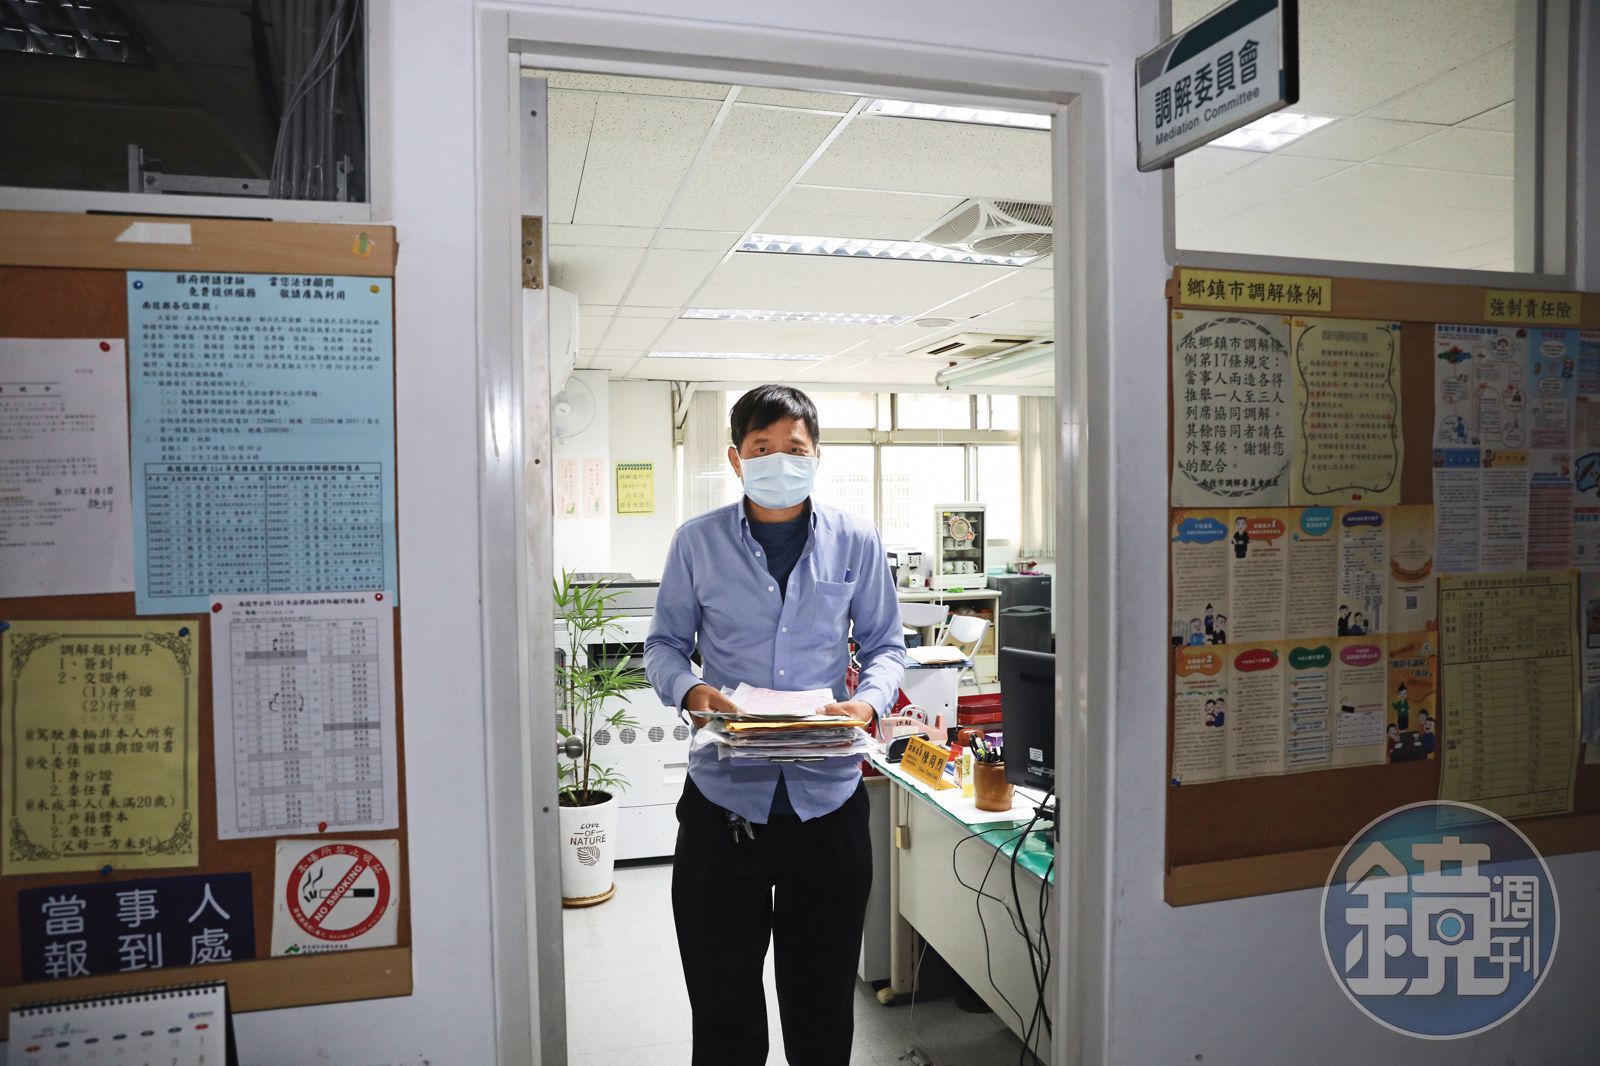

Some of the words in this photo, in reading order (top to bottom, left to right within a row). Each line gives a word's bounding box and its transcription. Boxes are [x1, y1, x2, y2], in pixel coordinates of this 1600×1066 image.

[1155, 39, 1259, 129] 調解委員會
[1155, 117, 1200, 146] Mediation
[1203, 87, 1260, 122] Committee
[1187, 277, 1322, 306] 鄉鎮市調解條例
[1490, 297, 1572, 319] 強制責任險
[1184, 335, 1284, 353] 依鄉鎮市調解條
[1184, 353, 1280, 370] 例第17條規定：
[1184, 372, 1284, 386] 當事人兩造各得
[1184, 388, 1284, 403] 推舉一人至三人
[1184, 405, 1281, 420] 列席協同調解。
[1185, 423, 1285, 439] 其餘陪同者請在
[1185, 440, 1285, 456] 外等候，謝謝您
[1185, 458, 1238, 473] 的配合。
[59, 643, 153, 656] 調解報到程序
[82, 700, 137, 713] (2)行照
[570, 834, 607, 846] NATURE
[314, 907, 329, 921] NO
[326, 865, 363, 906] SMOKING
[41, 882, 231, 937] 當事人
[43, 928, 233, 979] 報到處
